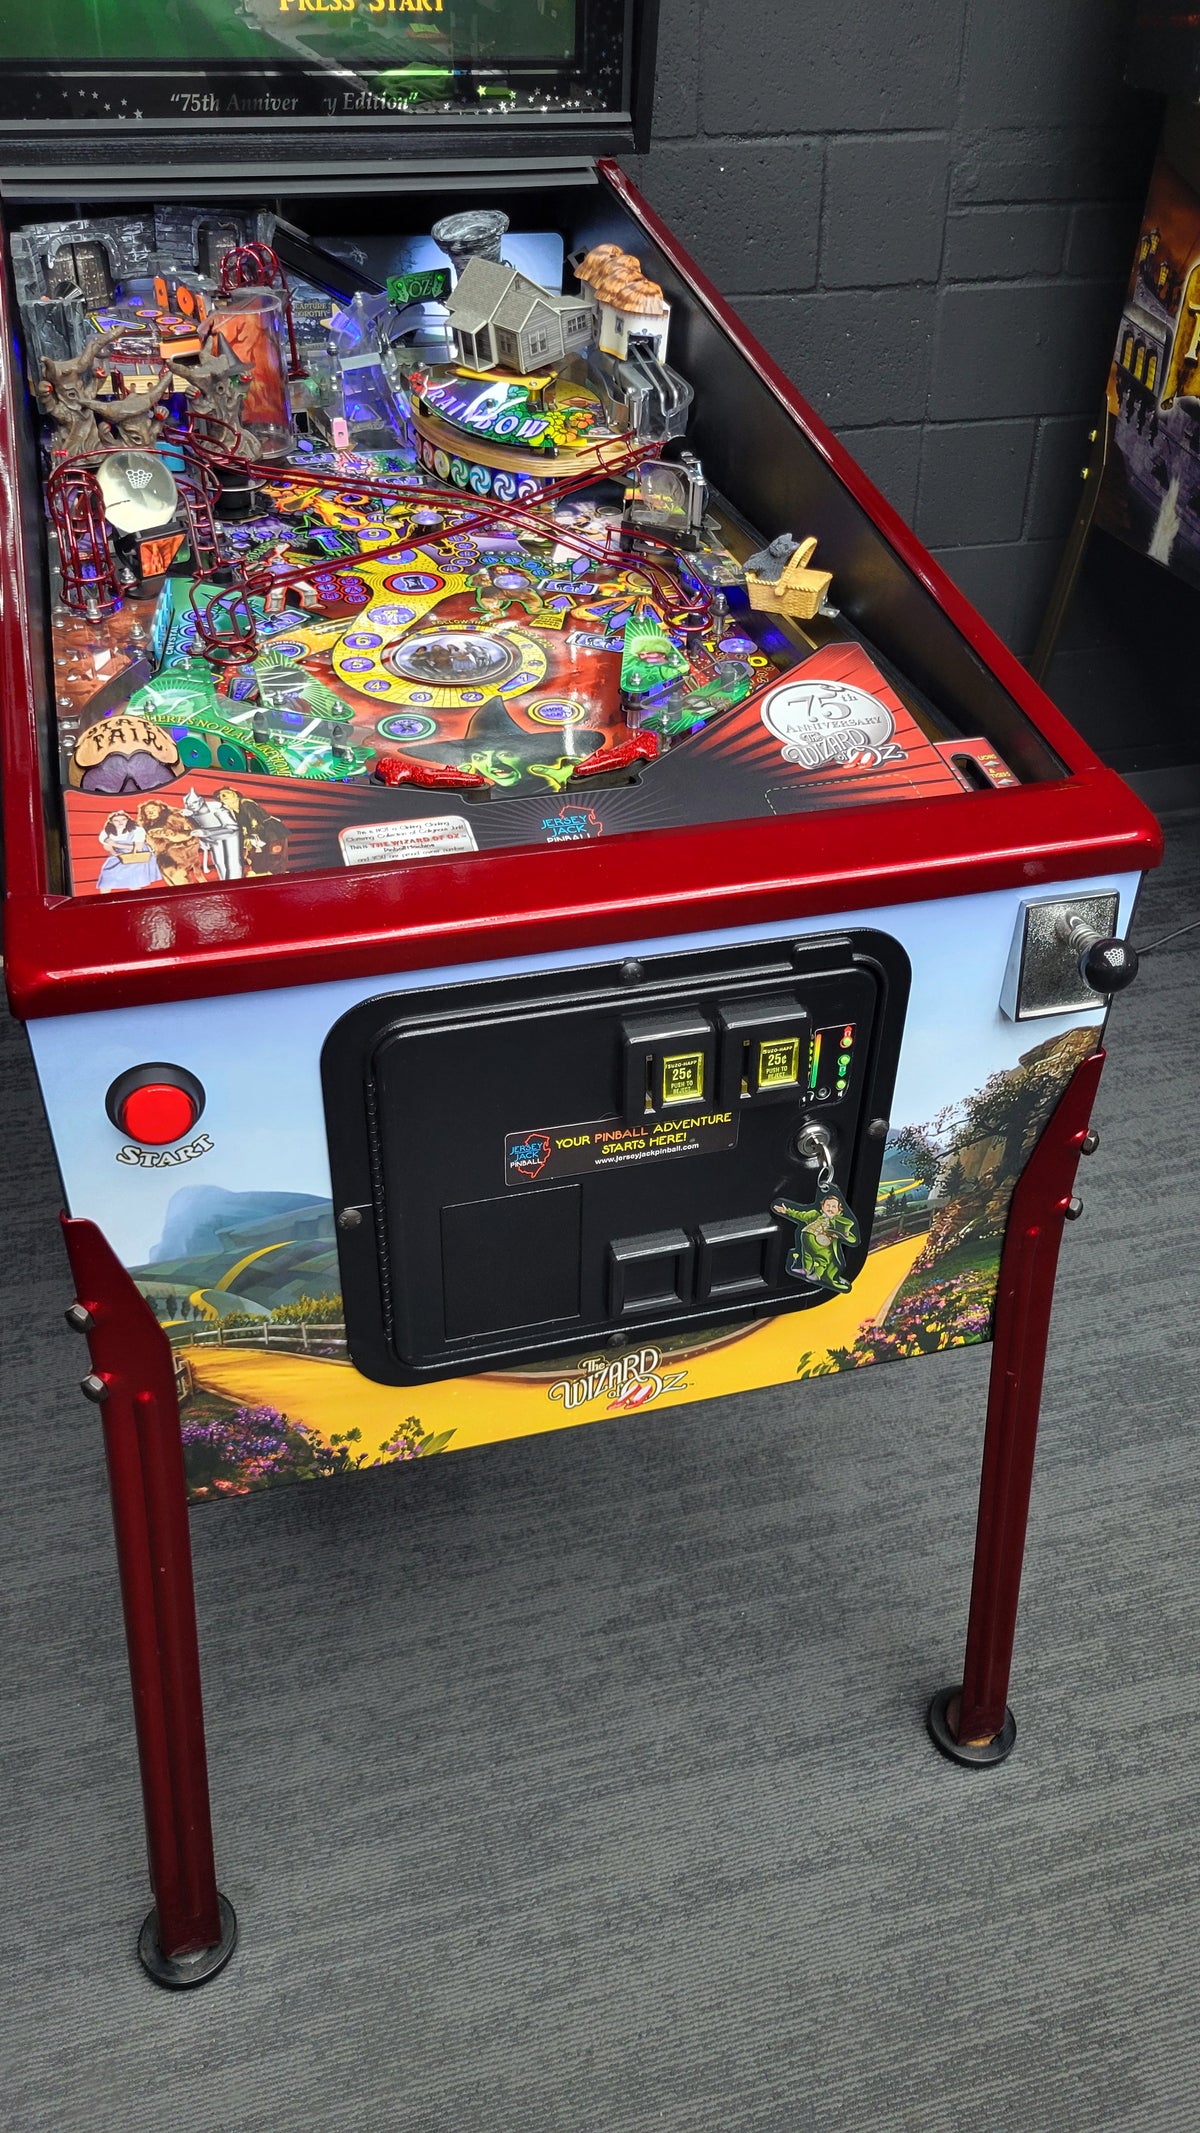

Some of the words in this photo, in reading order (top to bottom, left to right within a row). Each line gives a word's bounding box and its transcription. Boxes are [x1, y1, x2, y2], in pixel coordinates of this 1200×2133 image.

[408, 279, 432, 298] OZ
[427, 387, 551, 439] RAINBOW
[165, 624, 180, 656] CRYSTAL
[355, 636, 370, 647] 6
[371, 681, 382, 691] 4
[467, 693, 477, 701] 2
[198, 719, 220, 731] NO
[786, 716, 882, 734] ANNIVERSARY
[93, 727, 164, 752] FAIR
[788, 728, 866, 766] WIZARD
[541, 814, 588, 829] JERSEY
[551, 824, 588, 838] JACK
[369, 841, 388, 849] THE
[390, 836, 430, 847] WIZARD
[431, 834, 444, 842] OF
[446, 832, 460, 840] OZ
[767, 1053, 787, 1067] 25¢
[672, 1067, 692, 1081] 25¢
[766, 1066, 780, 1075] PUSH
[555, 1135, 591, 1150] YOUR
[594, 1127, 648, 1144] PINBALL
[652, 1112, 733, 1135] ADVENTURE
[115, 1133, 215, 1168] START
[509, 1142, 544, 1156] JERSEY
[601, 1138, 646, 1155] STARTS
[649, 1132, 688, 1148] HERE!
[514, 1150, 540, 1162] JACK
[594, 1141, 700, 1166] www.jerseyjackpinball.com
[509, 1157, 544, 1169] PINBALL
[548, 1347, 661, 1409] WIZARD
